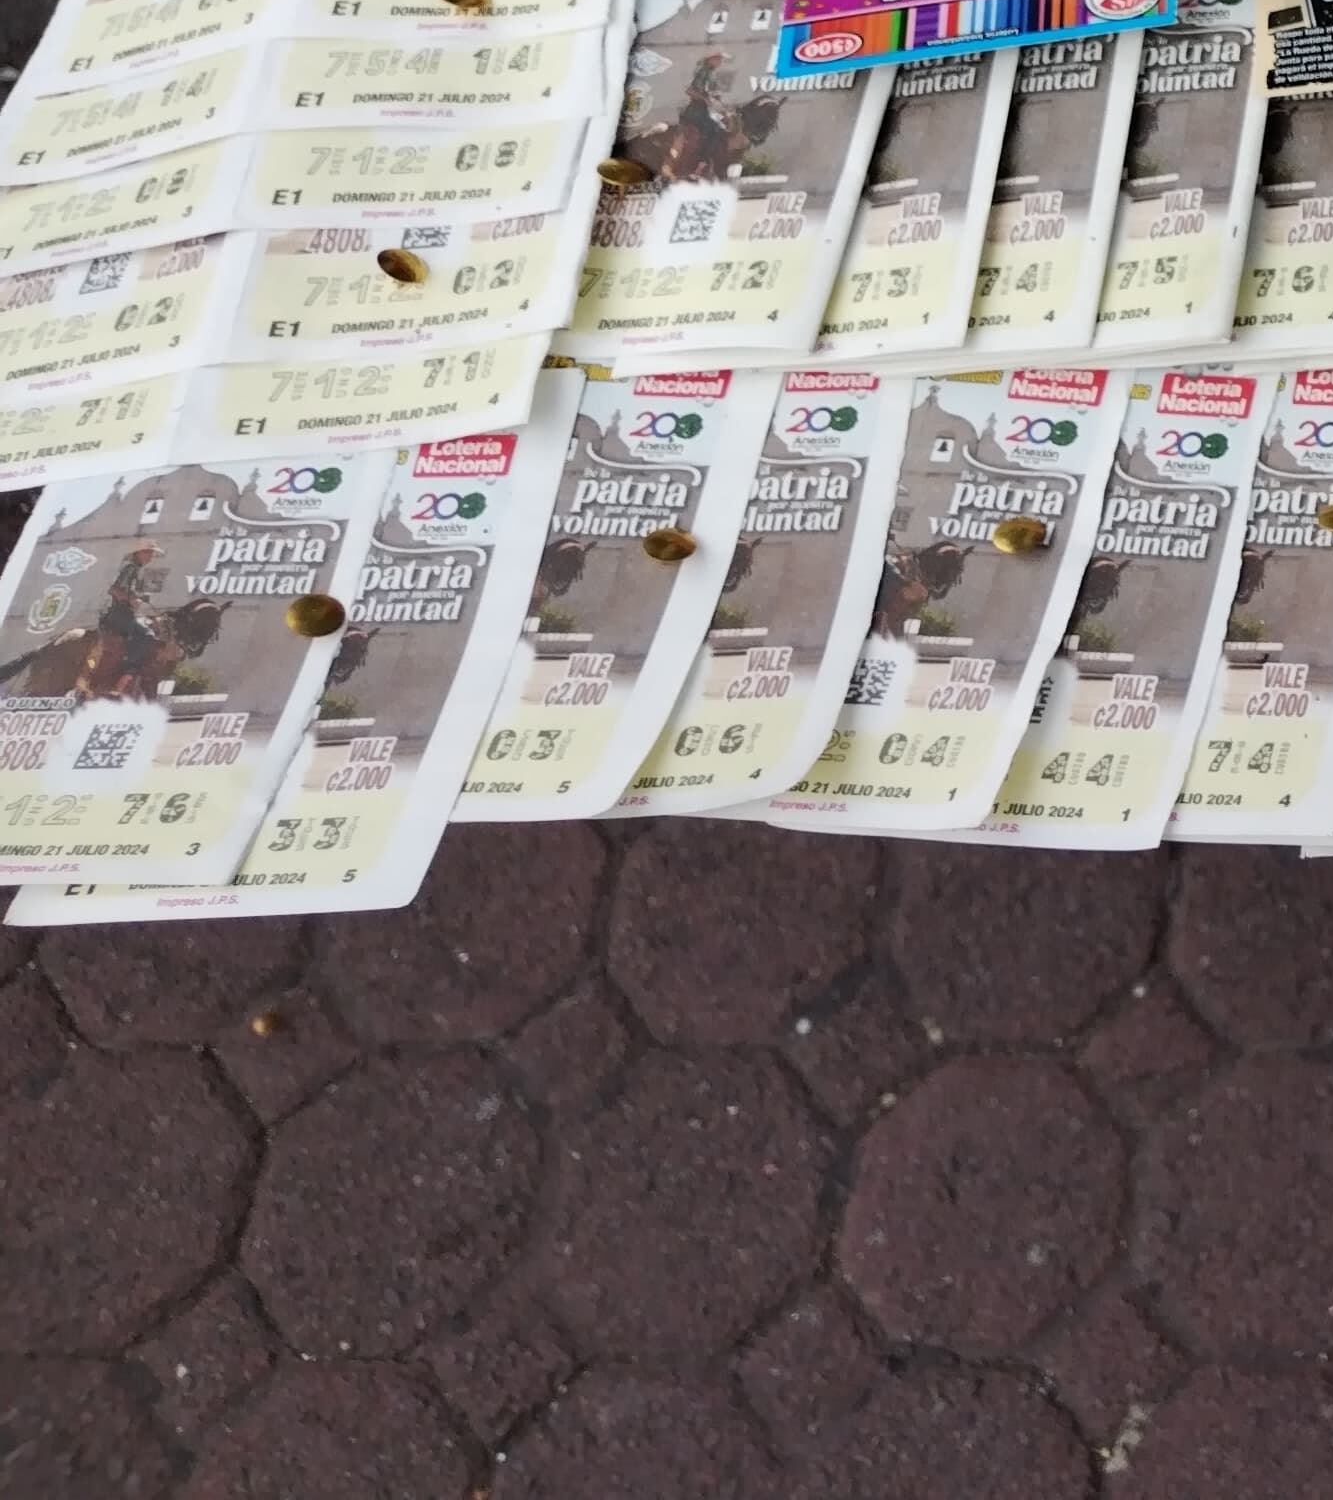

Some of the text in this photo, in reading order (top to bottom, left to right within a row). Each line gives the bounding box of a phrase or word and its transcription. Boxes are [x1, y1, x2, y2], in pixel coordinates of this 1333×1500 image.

[1160, 395, 1247, 416] Nacional
[1105, 494, 1218, 530] patria
[208, 529, 327, 569] patria
[185, 570, 314, 597] voluntad
[201, 715, 244, 738] VALE
